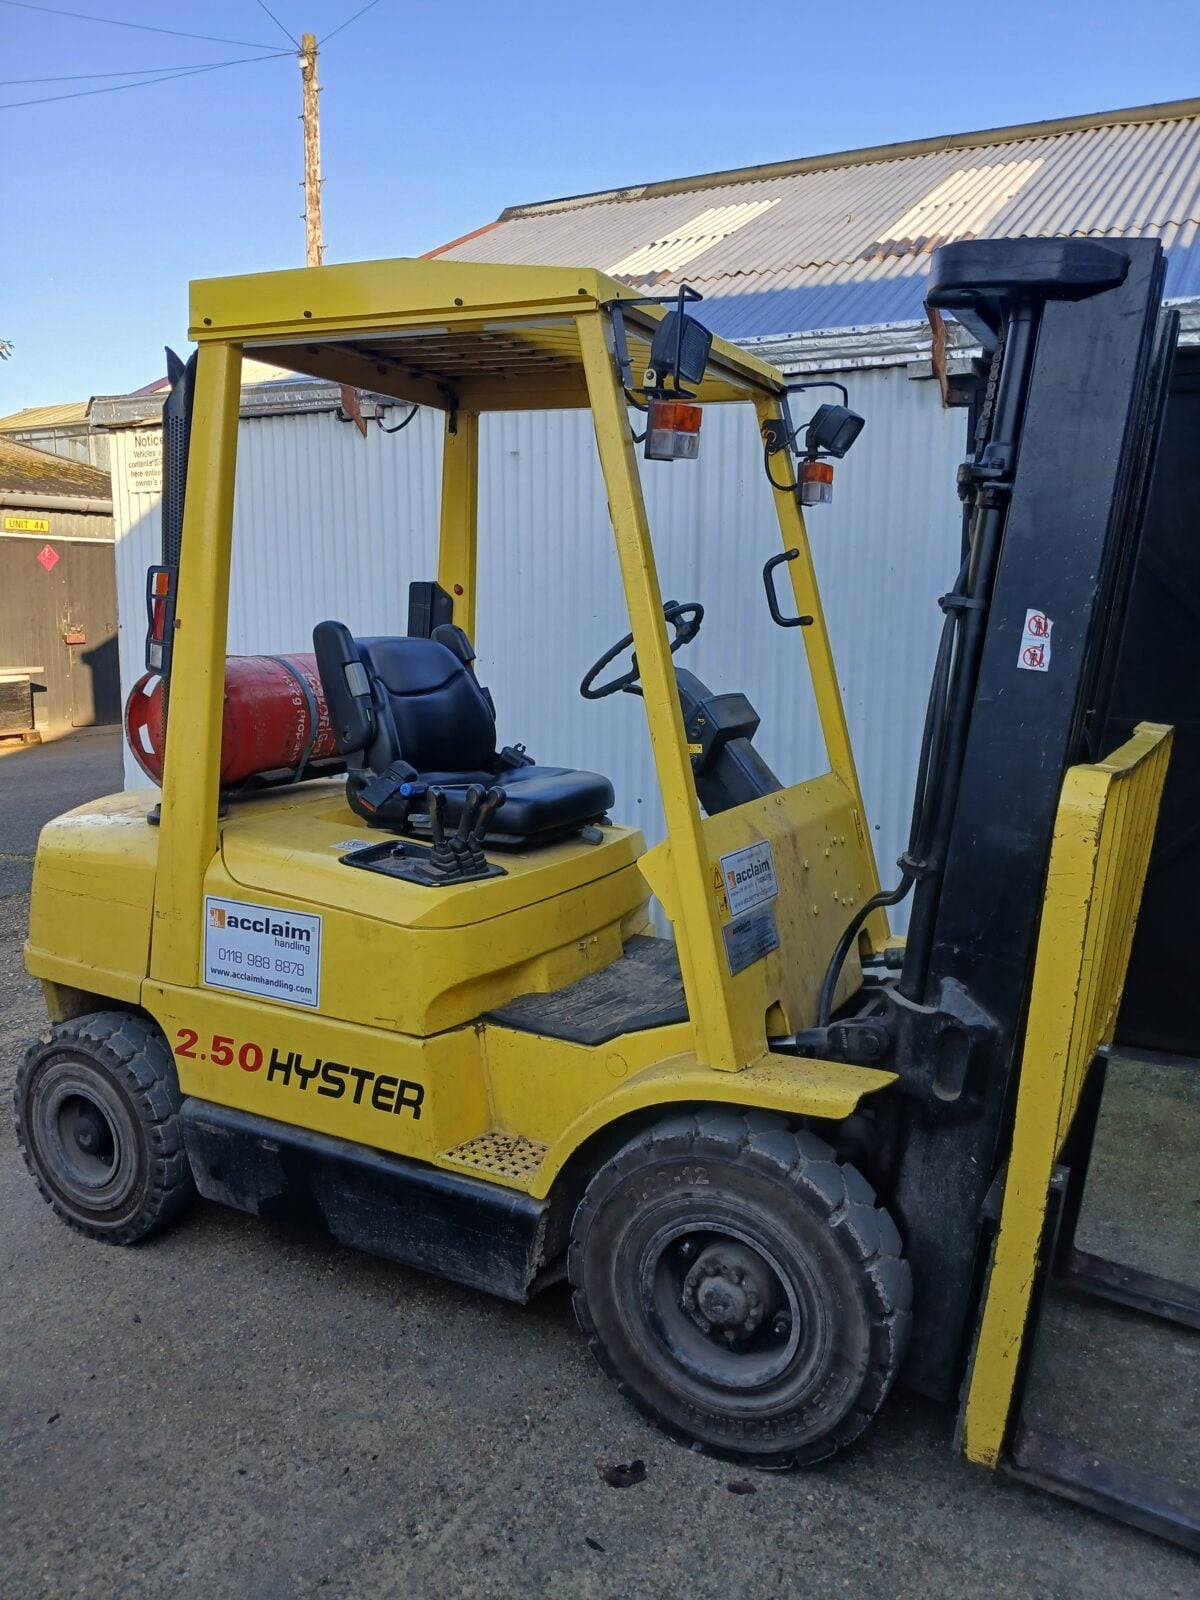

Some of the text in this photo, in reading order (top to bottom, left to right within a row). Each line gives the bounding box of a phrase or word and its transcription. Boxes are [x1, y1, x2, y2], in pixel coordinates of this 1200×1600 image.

[133, 450, 156, 458] Vehicles
[130, 470, 143, 478] here
[9, 519, 45, 530] UNIT 4A
[736, 858, 771, 884] acclaim
[226, 917, 311, 942] acclaim
[274, 937, 311, 955] handling
[218, 947, 305, 977] 0118 988 8878
[210, 967, 313, 995] www.acclaimhandling.com
[174, 1028, 425, 1120] 2.50 HYSTER
